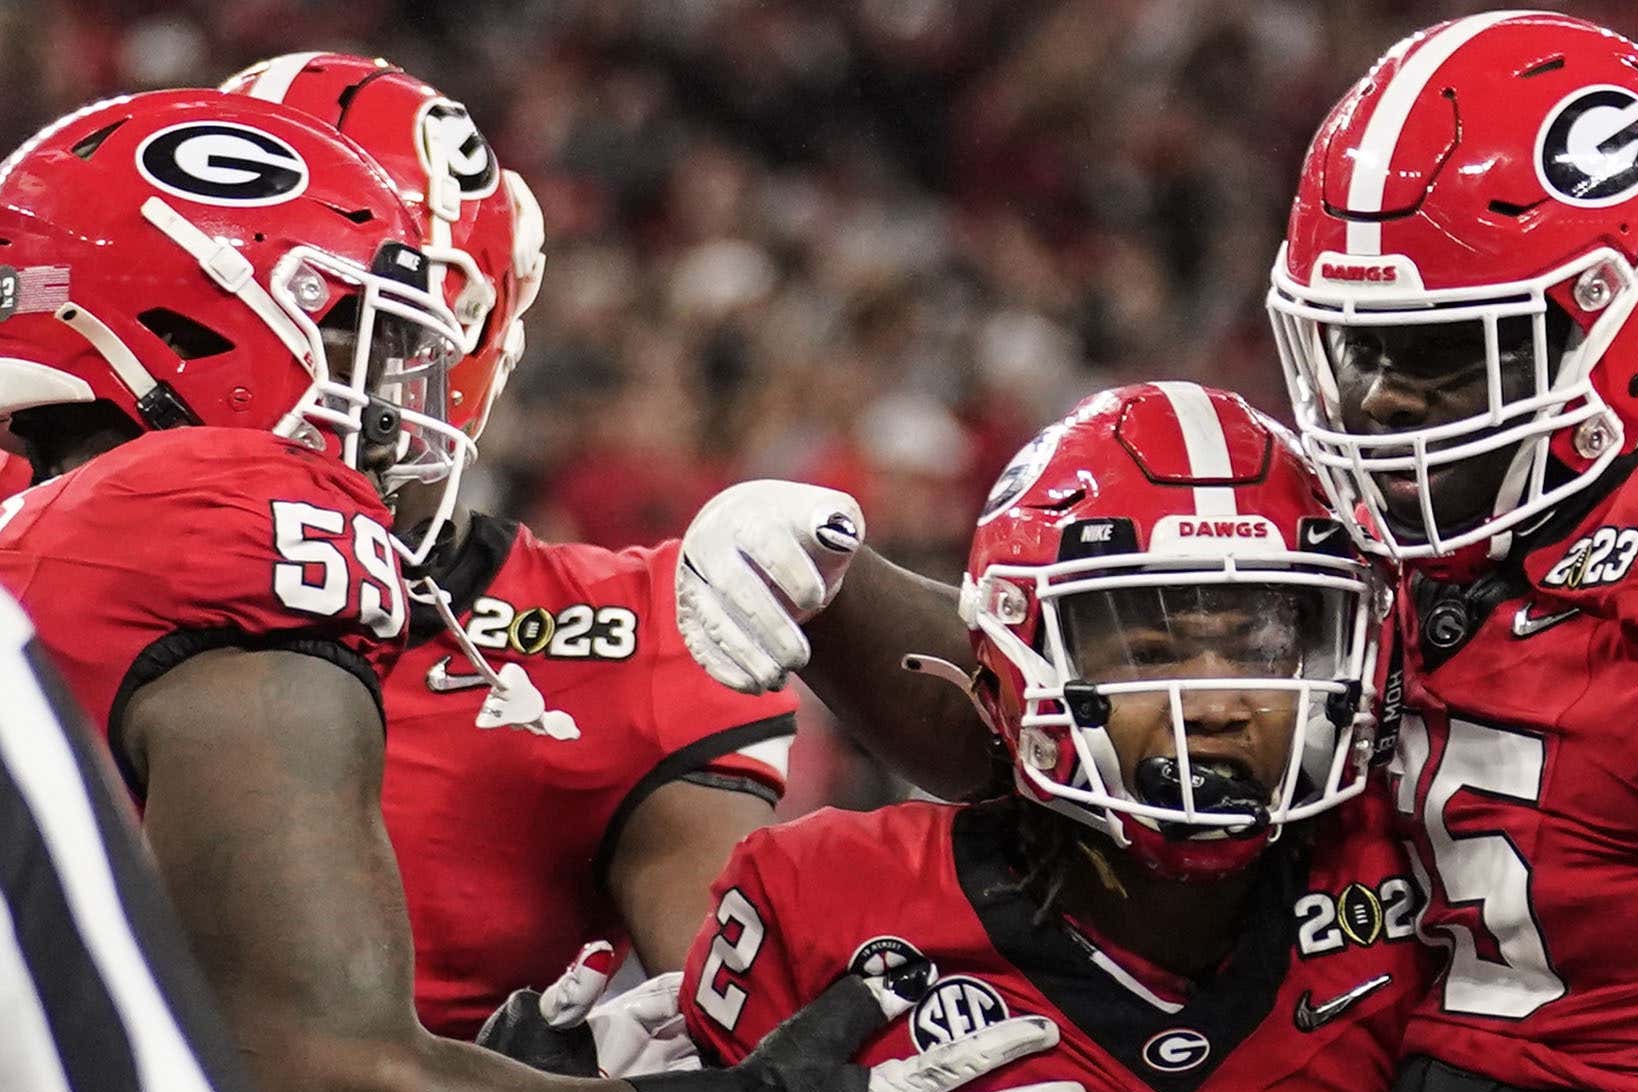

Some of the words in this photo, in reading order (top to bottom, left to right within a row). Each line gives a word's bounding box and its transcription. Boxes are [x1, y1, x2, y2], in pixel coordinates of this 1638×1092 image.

[141, 125, 305, 203] G
[1322, 263, 1397, 281] DAWGS
[1080, 523, 1115, 542] NIKE
[1179, 521, 1268, 538] DAWGS
[271, 500, 406, 639] 59
[465, 596, 638, 659] 2023
[1293, 878, 1415, 955] 202
[696, 888, 765, 1032] 2
[917, 982, 996, 1048] SEC
[1145, 1030, 1209, 1071] G
